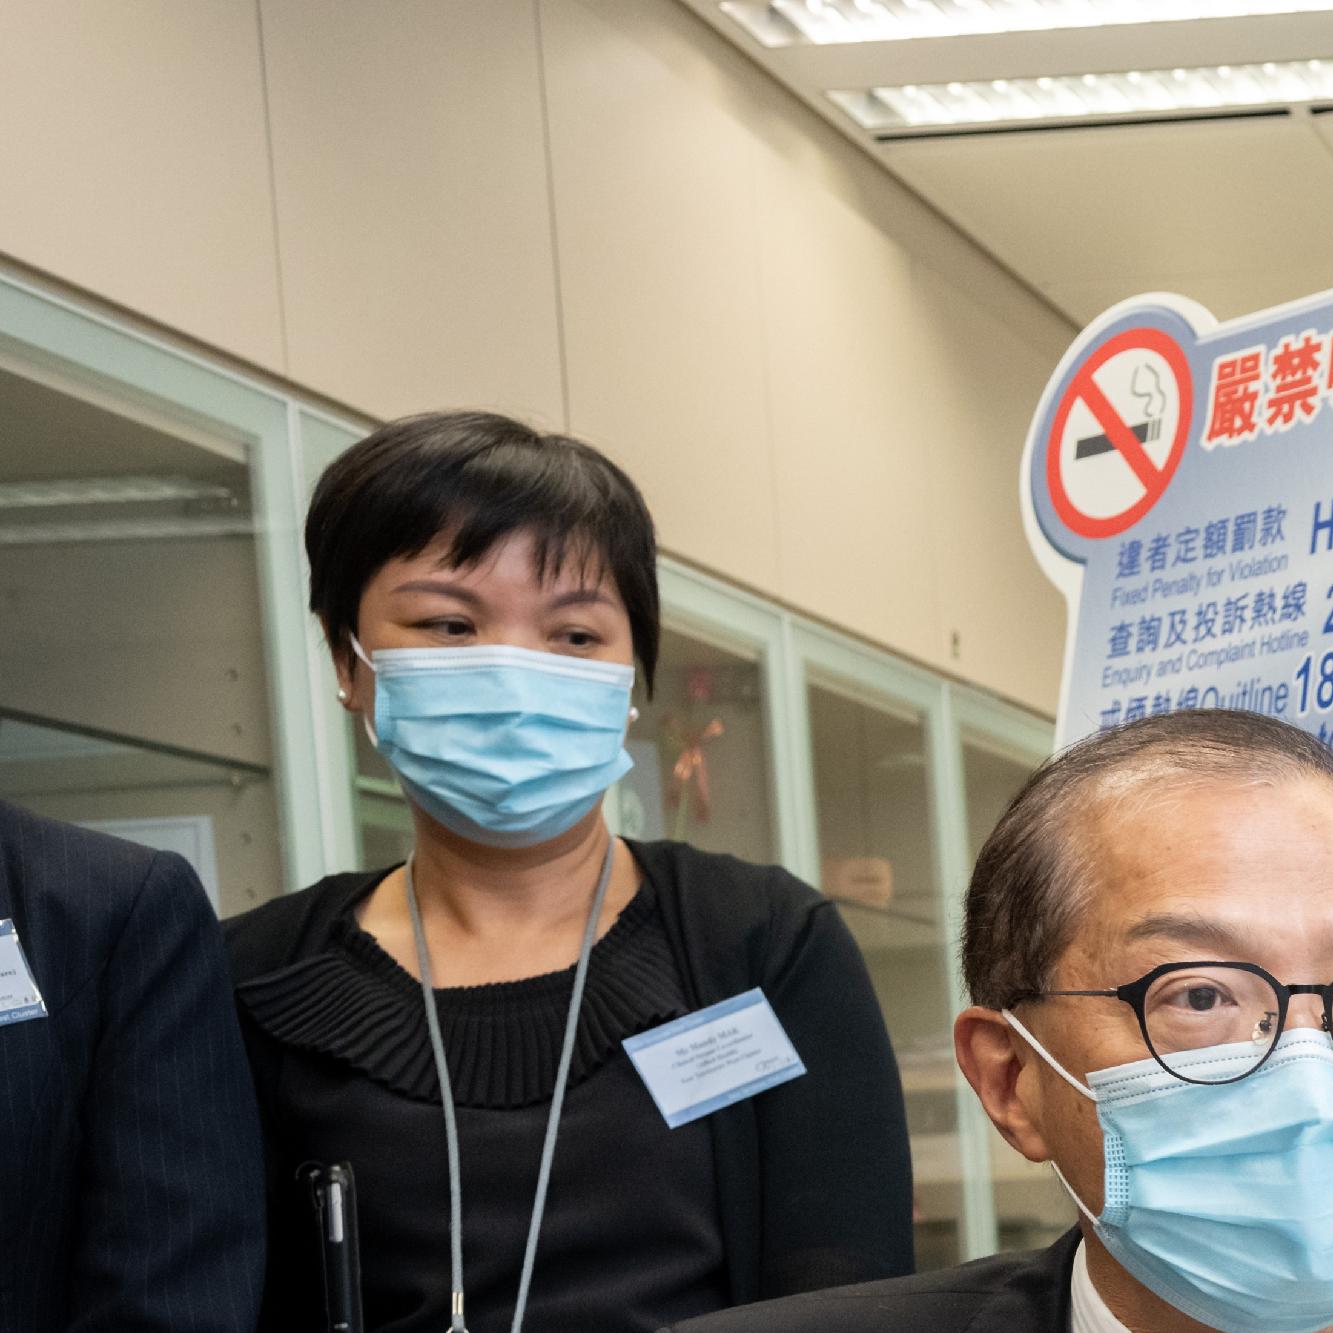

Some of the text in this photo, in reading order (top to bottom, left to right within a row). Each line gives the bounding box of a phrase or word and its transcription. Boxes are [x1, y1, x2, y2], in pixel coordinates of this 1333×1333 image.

[1116, 503, 1287, 579] 違者定額罰款
[1111, 554, 1288, 609] Fixed Penalty for Violation
[1107, 581, 1307, 659] 查詢及投訴熱線
[1102, 629, 1309, 688] Enquiry and Complaint Hotline
